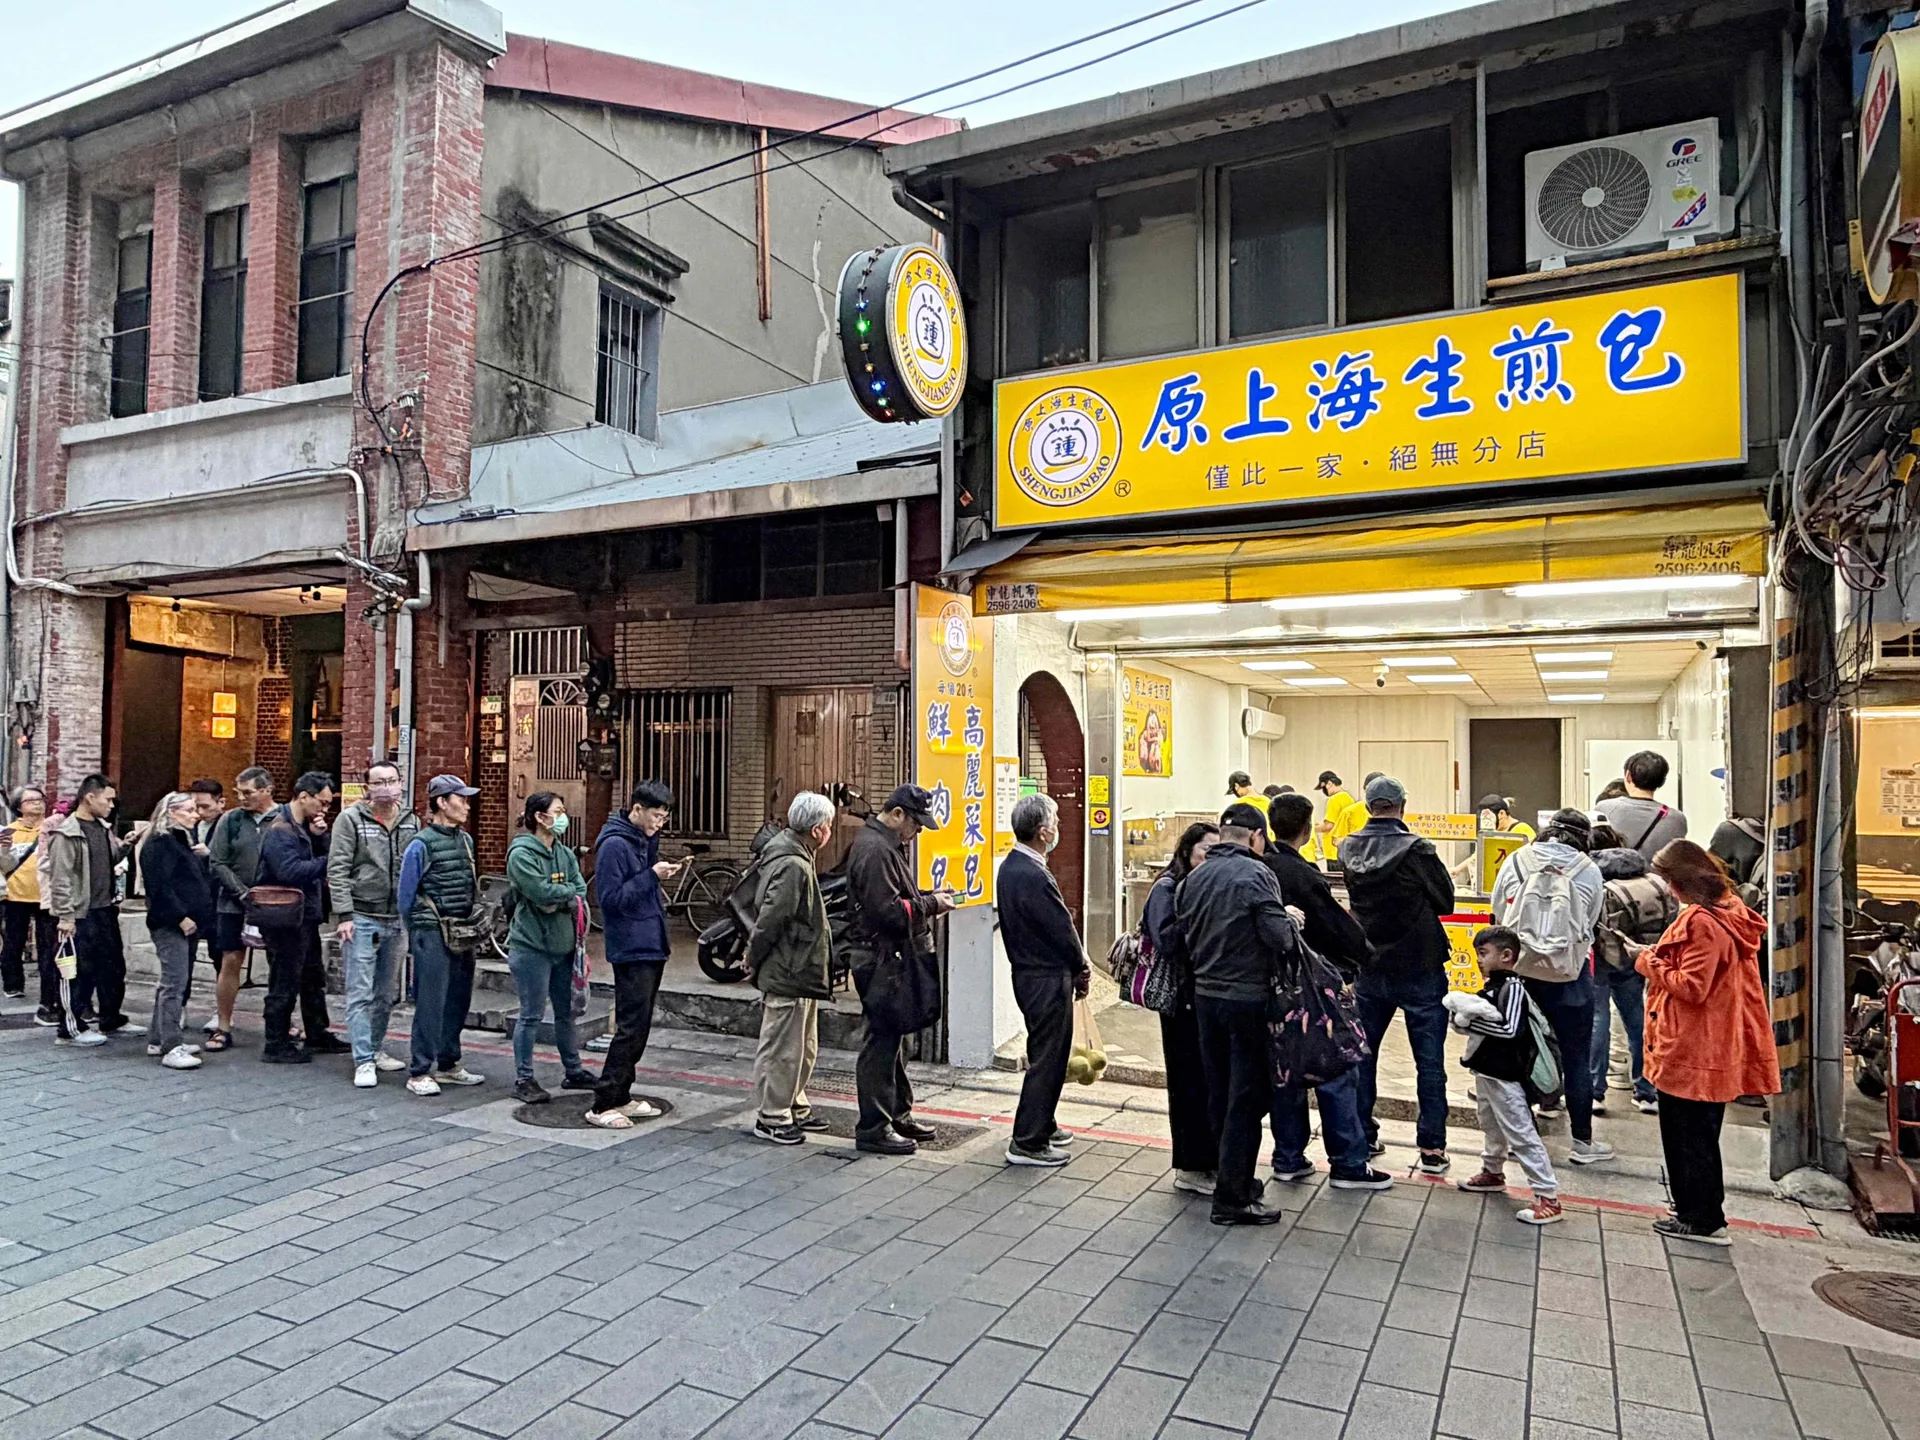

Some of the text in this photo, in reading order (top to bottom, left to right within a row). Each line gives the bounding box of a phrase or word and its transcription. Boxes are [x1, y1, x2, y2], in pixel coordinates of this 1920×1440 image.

[1665, 154, 1704, 168] GREE
[900, 332, 958, 401] SHENGJIANBAO
[1140, 307, 1683, 452] 原上海生煎包
[1022, 393, 1106, 432] 原上海生煎包
[1019, 455, 1111, 500] SHENGJIANBAO
[962, 704, 987, 899] 高麗菜包
